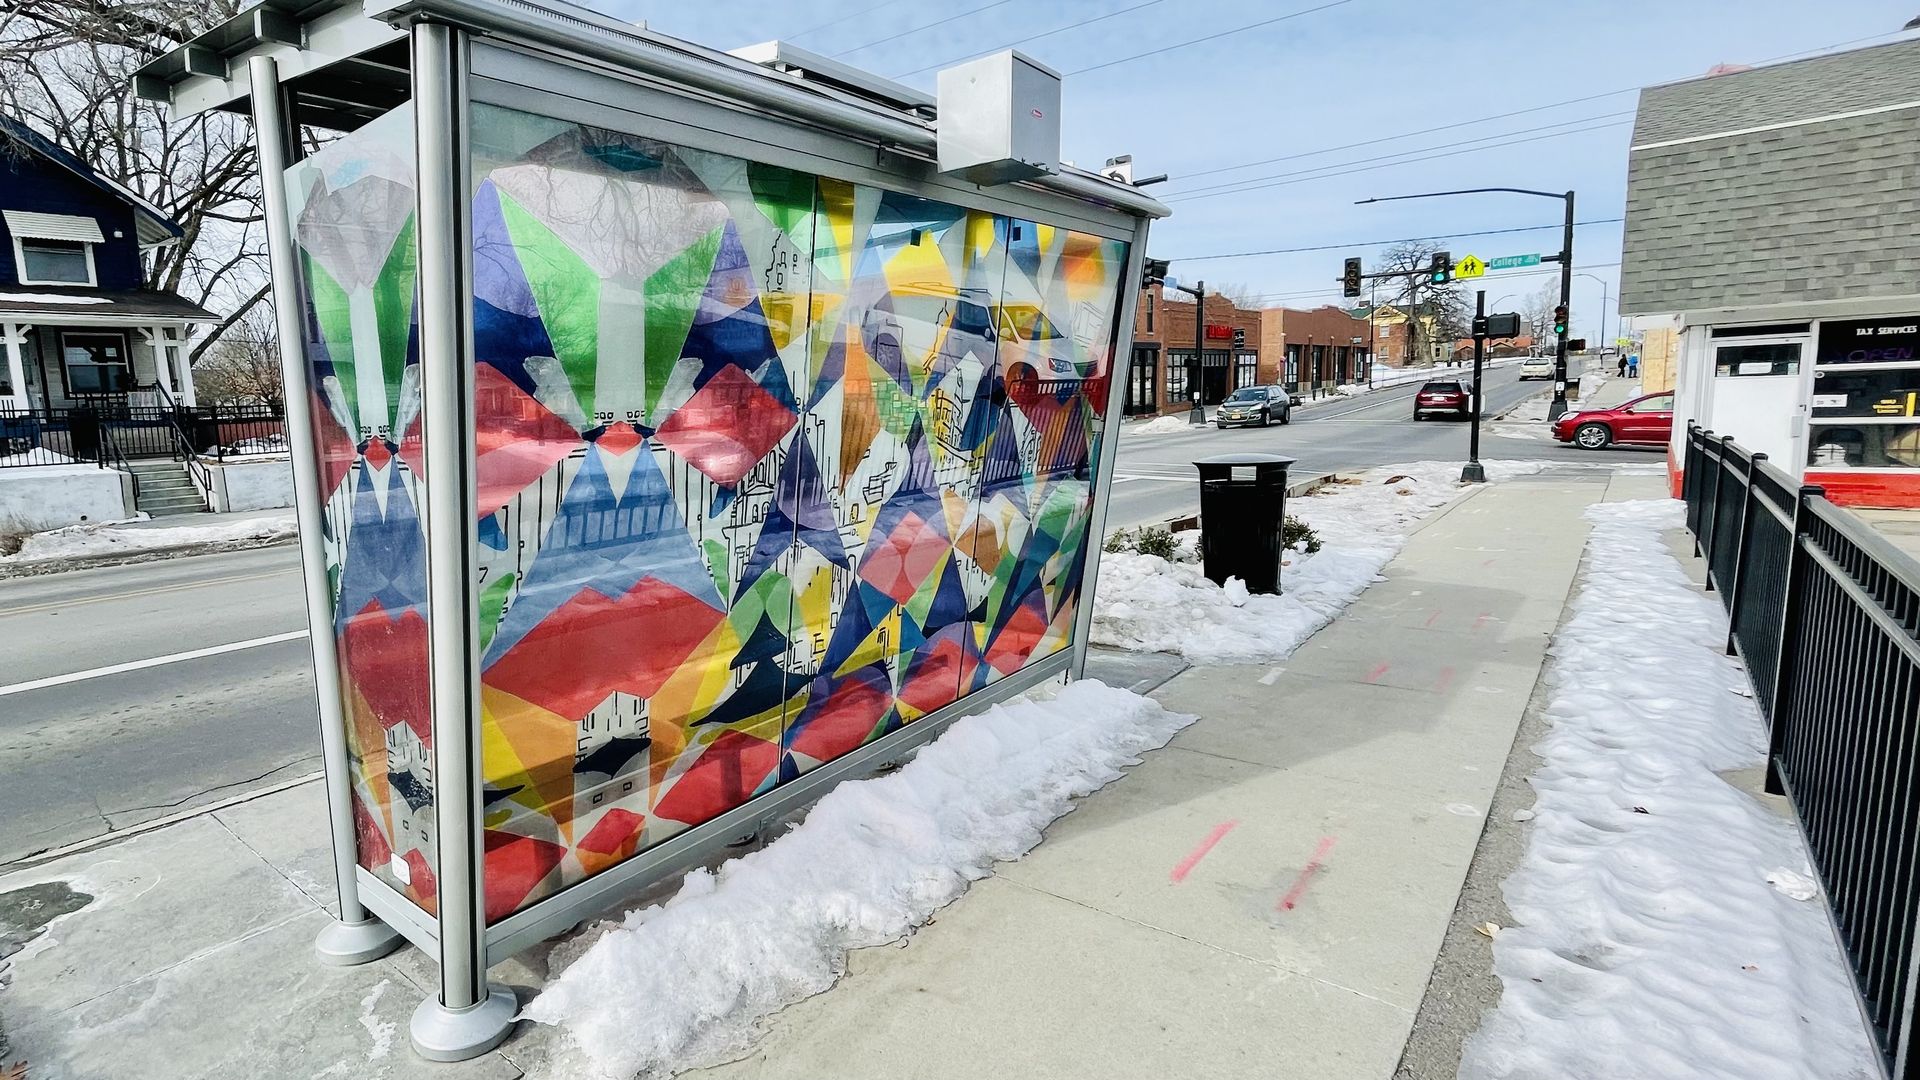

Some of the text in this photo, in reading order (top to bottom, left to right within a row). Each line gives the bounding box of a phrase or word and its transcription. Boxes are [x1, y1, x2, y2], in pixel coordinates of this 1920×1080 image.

[1492, 257, 1522, 267] College
[1856, 324, 1918, 336] TAX SERVICES
[1848, 347, 1914, 362] OPEN
